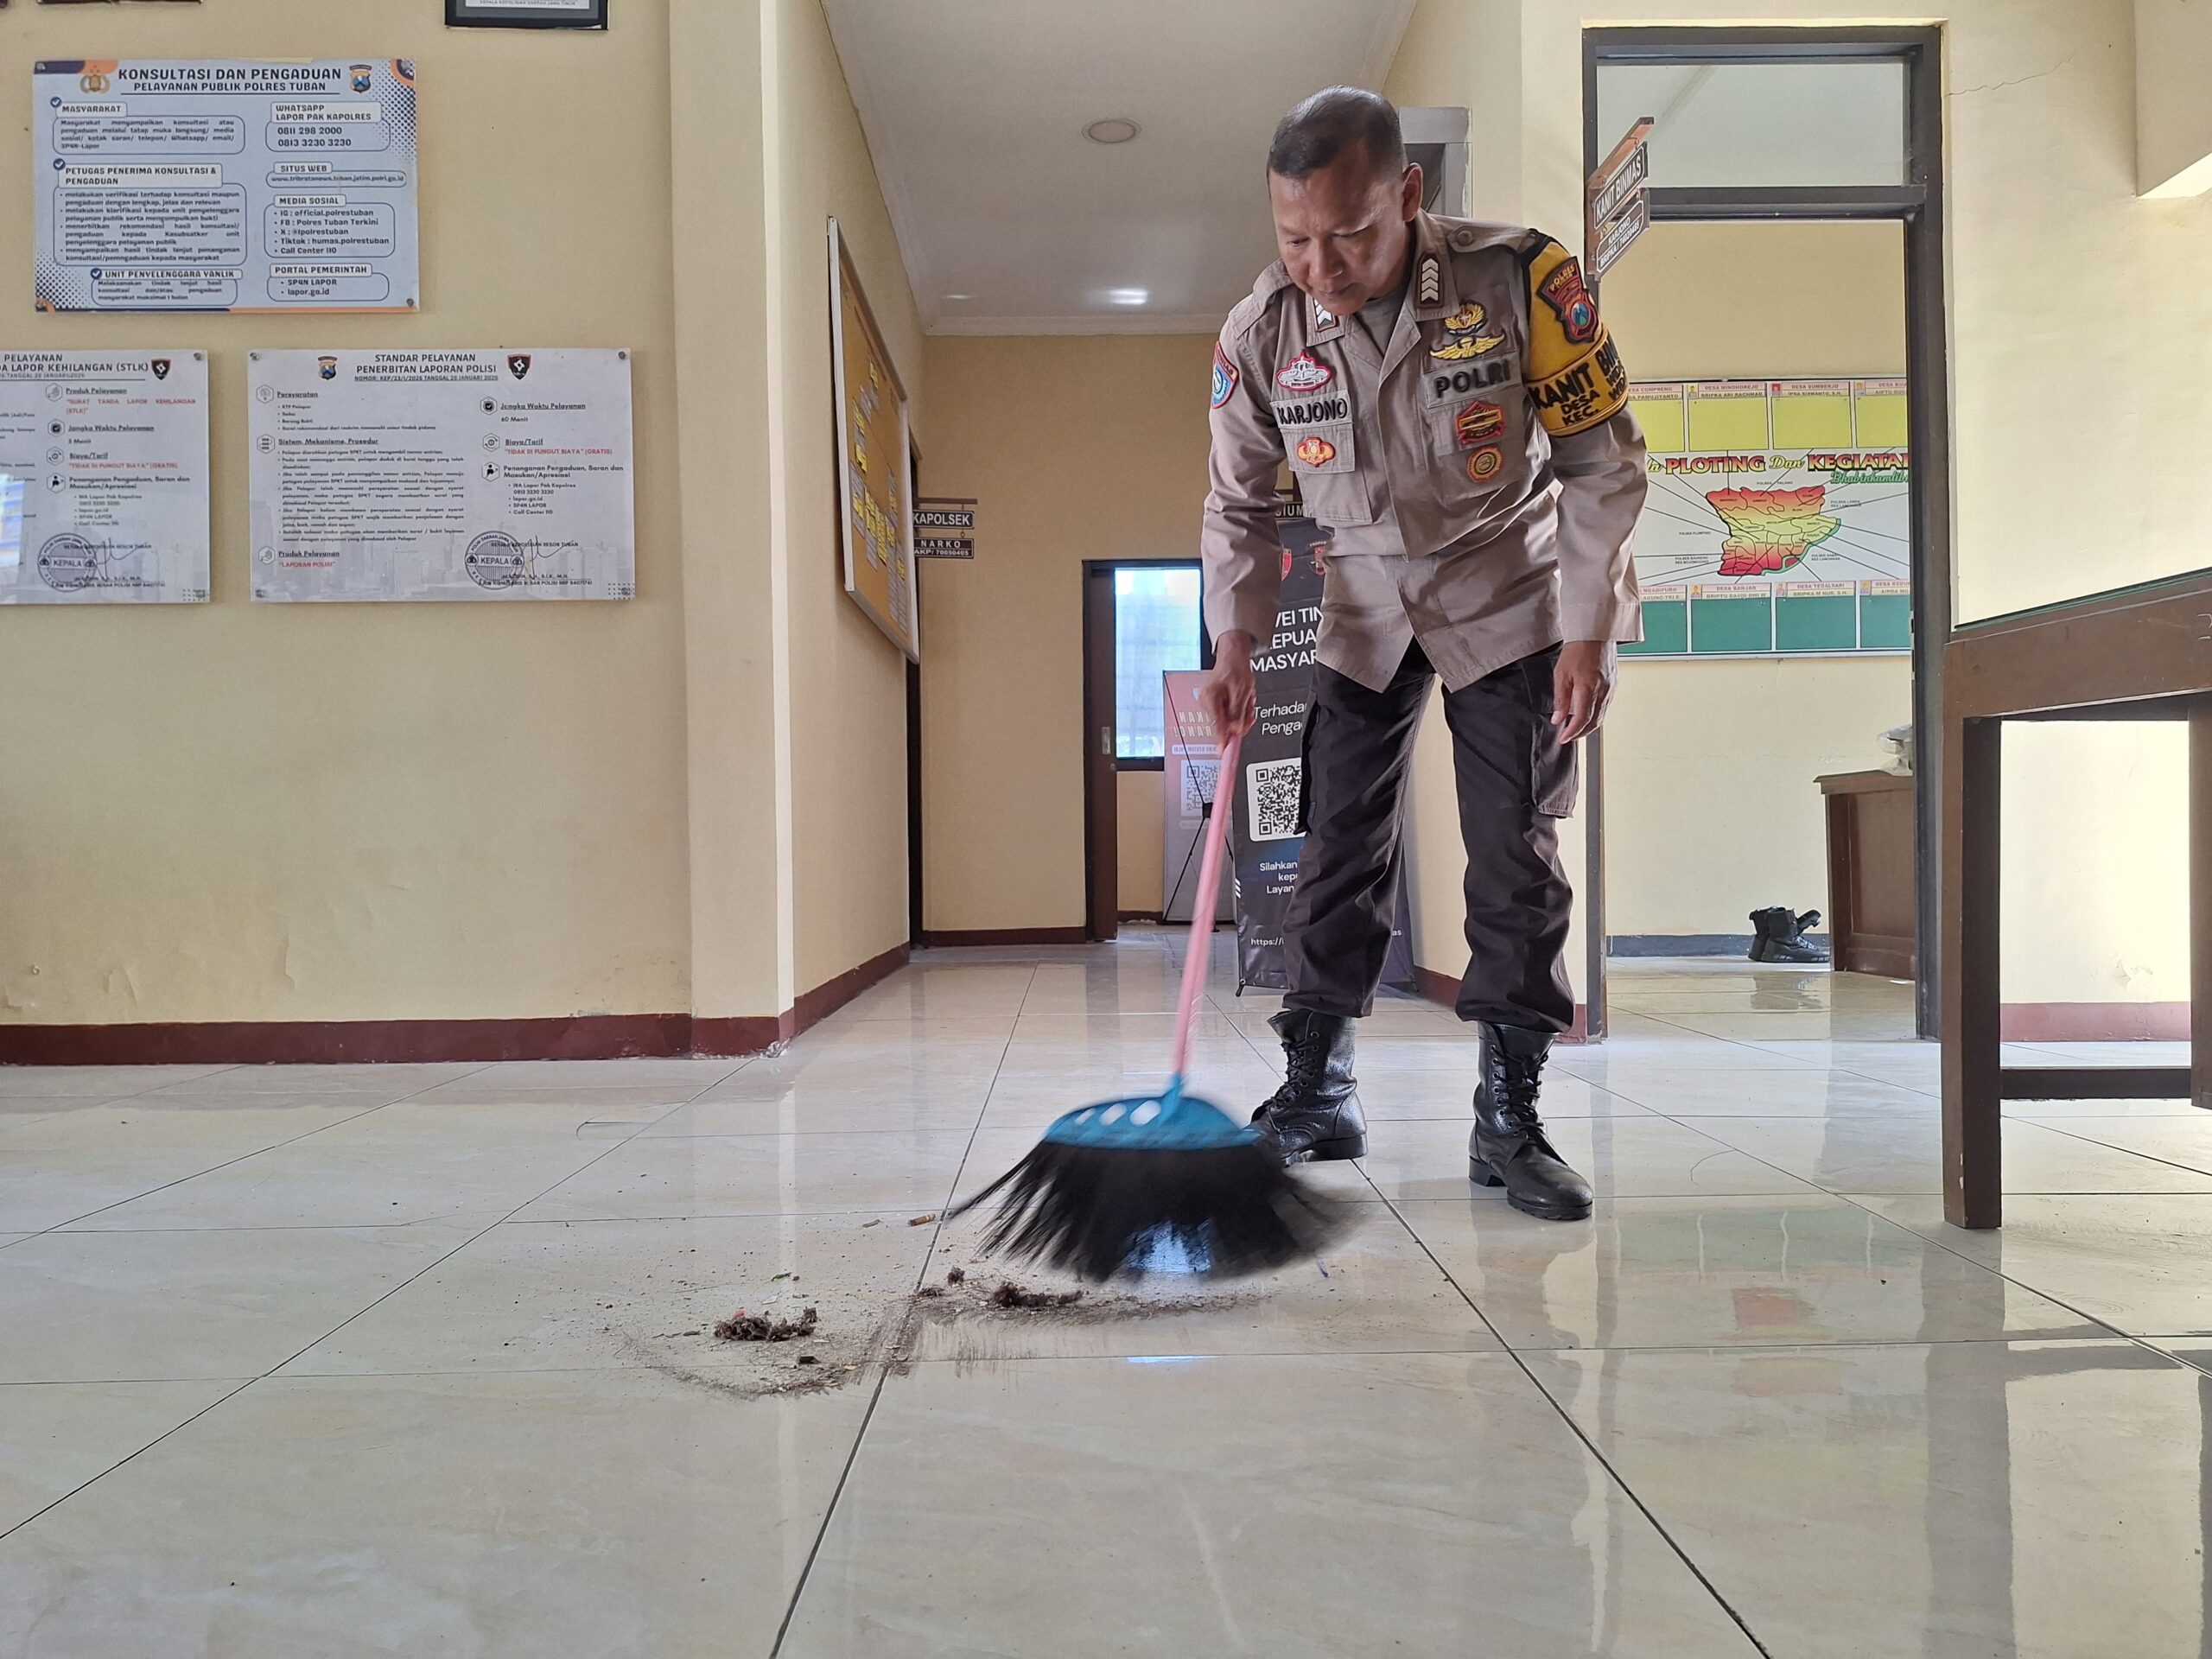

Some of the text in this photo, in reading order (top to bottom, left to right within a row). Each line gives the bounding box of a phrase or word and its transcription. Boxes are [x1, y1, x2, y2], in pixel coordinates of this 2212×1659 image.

[118, 68, 340, 79] KONSULTASI DAN PENGADUAN
[134, 82, 325, 91] PELAYANAN PUBLIK POLRES TUBAN
[278, 138, 352, 147] 0813 3230 3230
[1596, 156, 1641, 223] KANIT BINMAS
[0, 363, 149, 372] A LAPOR KEHILANGAN (STLK)
[357, 365, 496, 373] PENERBITAN LAPORAN POLISI
[1434, 359, 1510, 398] POLRI
[1527, 362, 1594, 410] KANIT
[1560, 389, 1600, 415] DESA
[1561, 405, 1600, 426] KEC.
[1665, 454, 1766, 474] PLOTING
[1770, 454, 1805, 470] Dan
[913, 513, 970, 525] KAPOLSEK
[921, 540, 961, 549] NARKO
[1270, 630, 1317, 650] EPUA
[1262, 719, 1303, 736] Penga
[1259, 861, 1298, 872] Silahkan
